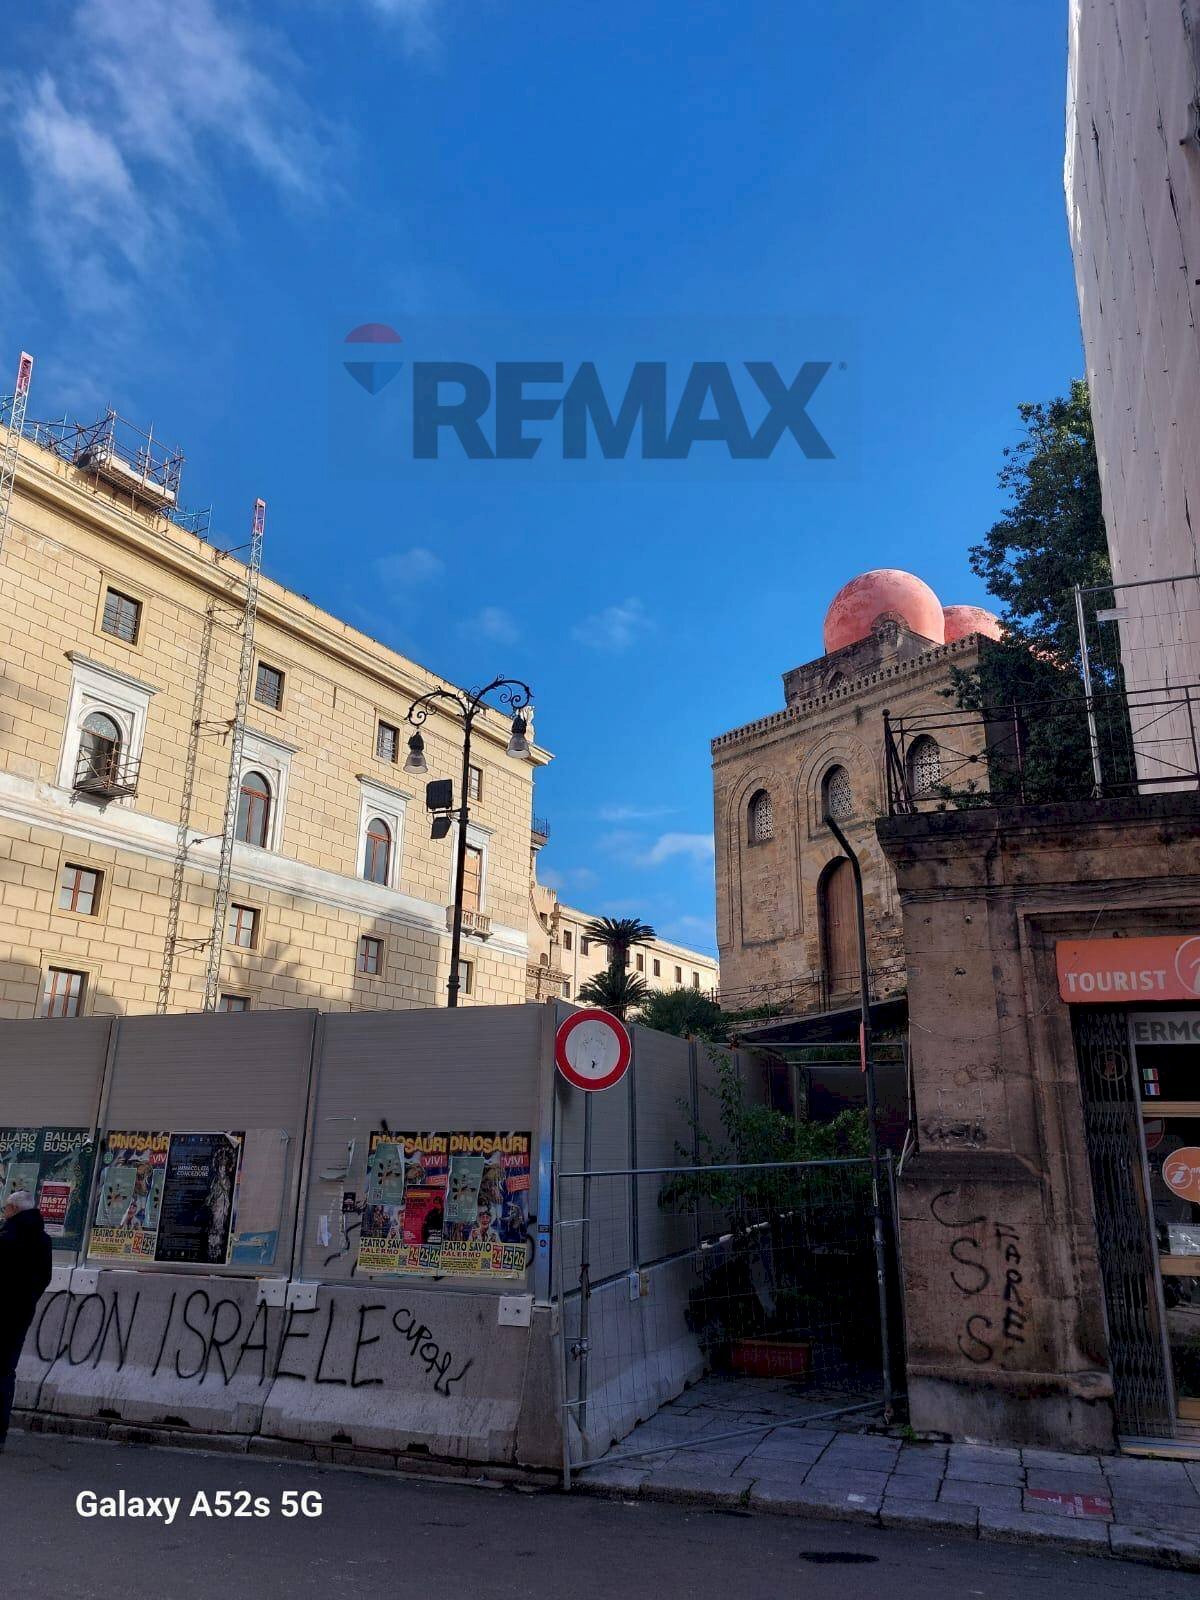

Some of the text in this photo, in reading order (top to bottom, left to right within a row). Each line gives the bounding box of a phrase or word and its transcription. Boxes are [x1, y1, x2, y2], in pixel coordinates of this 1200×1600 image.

[1064, 970, 1166, 993] TOURIST
[450, 1135, 528, 1153] DINOSAURI
[424, 1156, 443, 1167] VIVI
[92, 1228, 114, 1237] TEATRO
[92, 1236, 125, 1244] PALERMO
[359, 1247, 399, 1255] PALERMO
[469, 1241, 492, 1252] SAVIO
[441, 1250, 481, 1258] PALERMO
[491, 1249, 502, 1264] 24
[503, 1250, 513, 1265] 25
[514, 1251, 525, 1265] 26
[36, 1290, 387, 1388] CON ISRAELE
